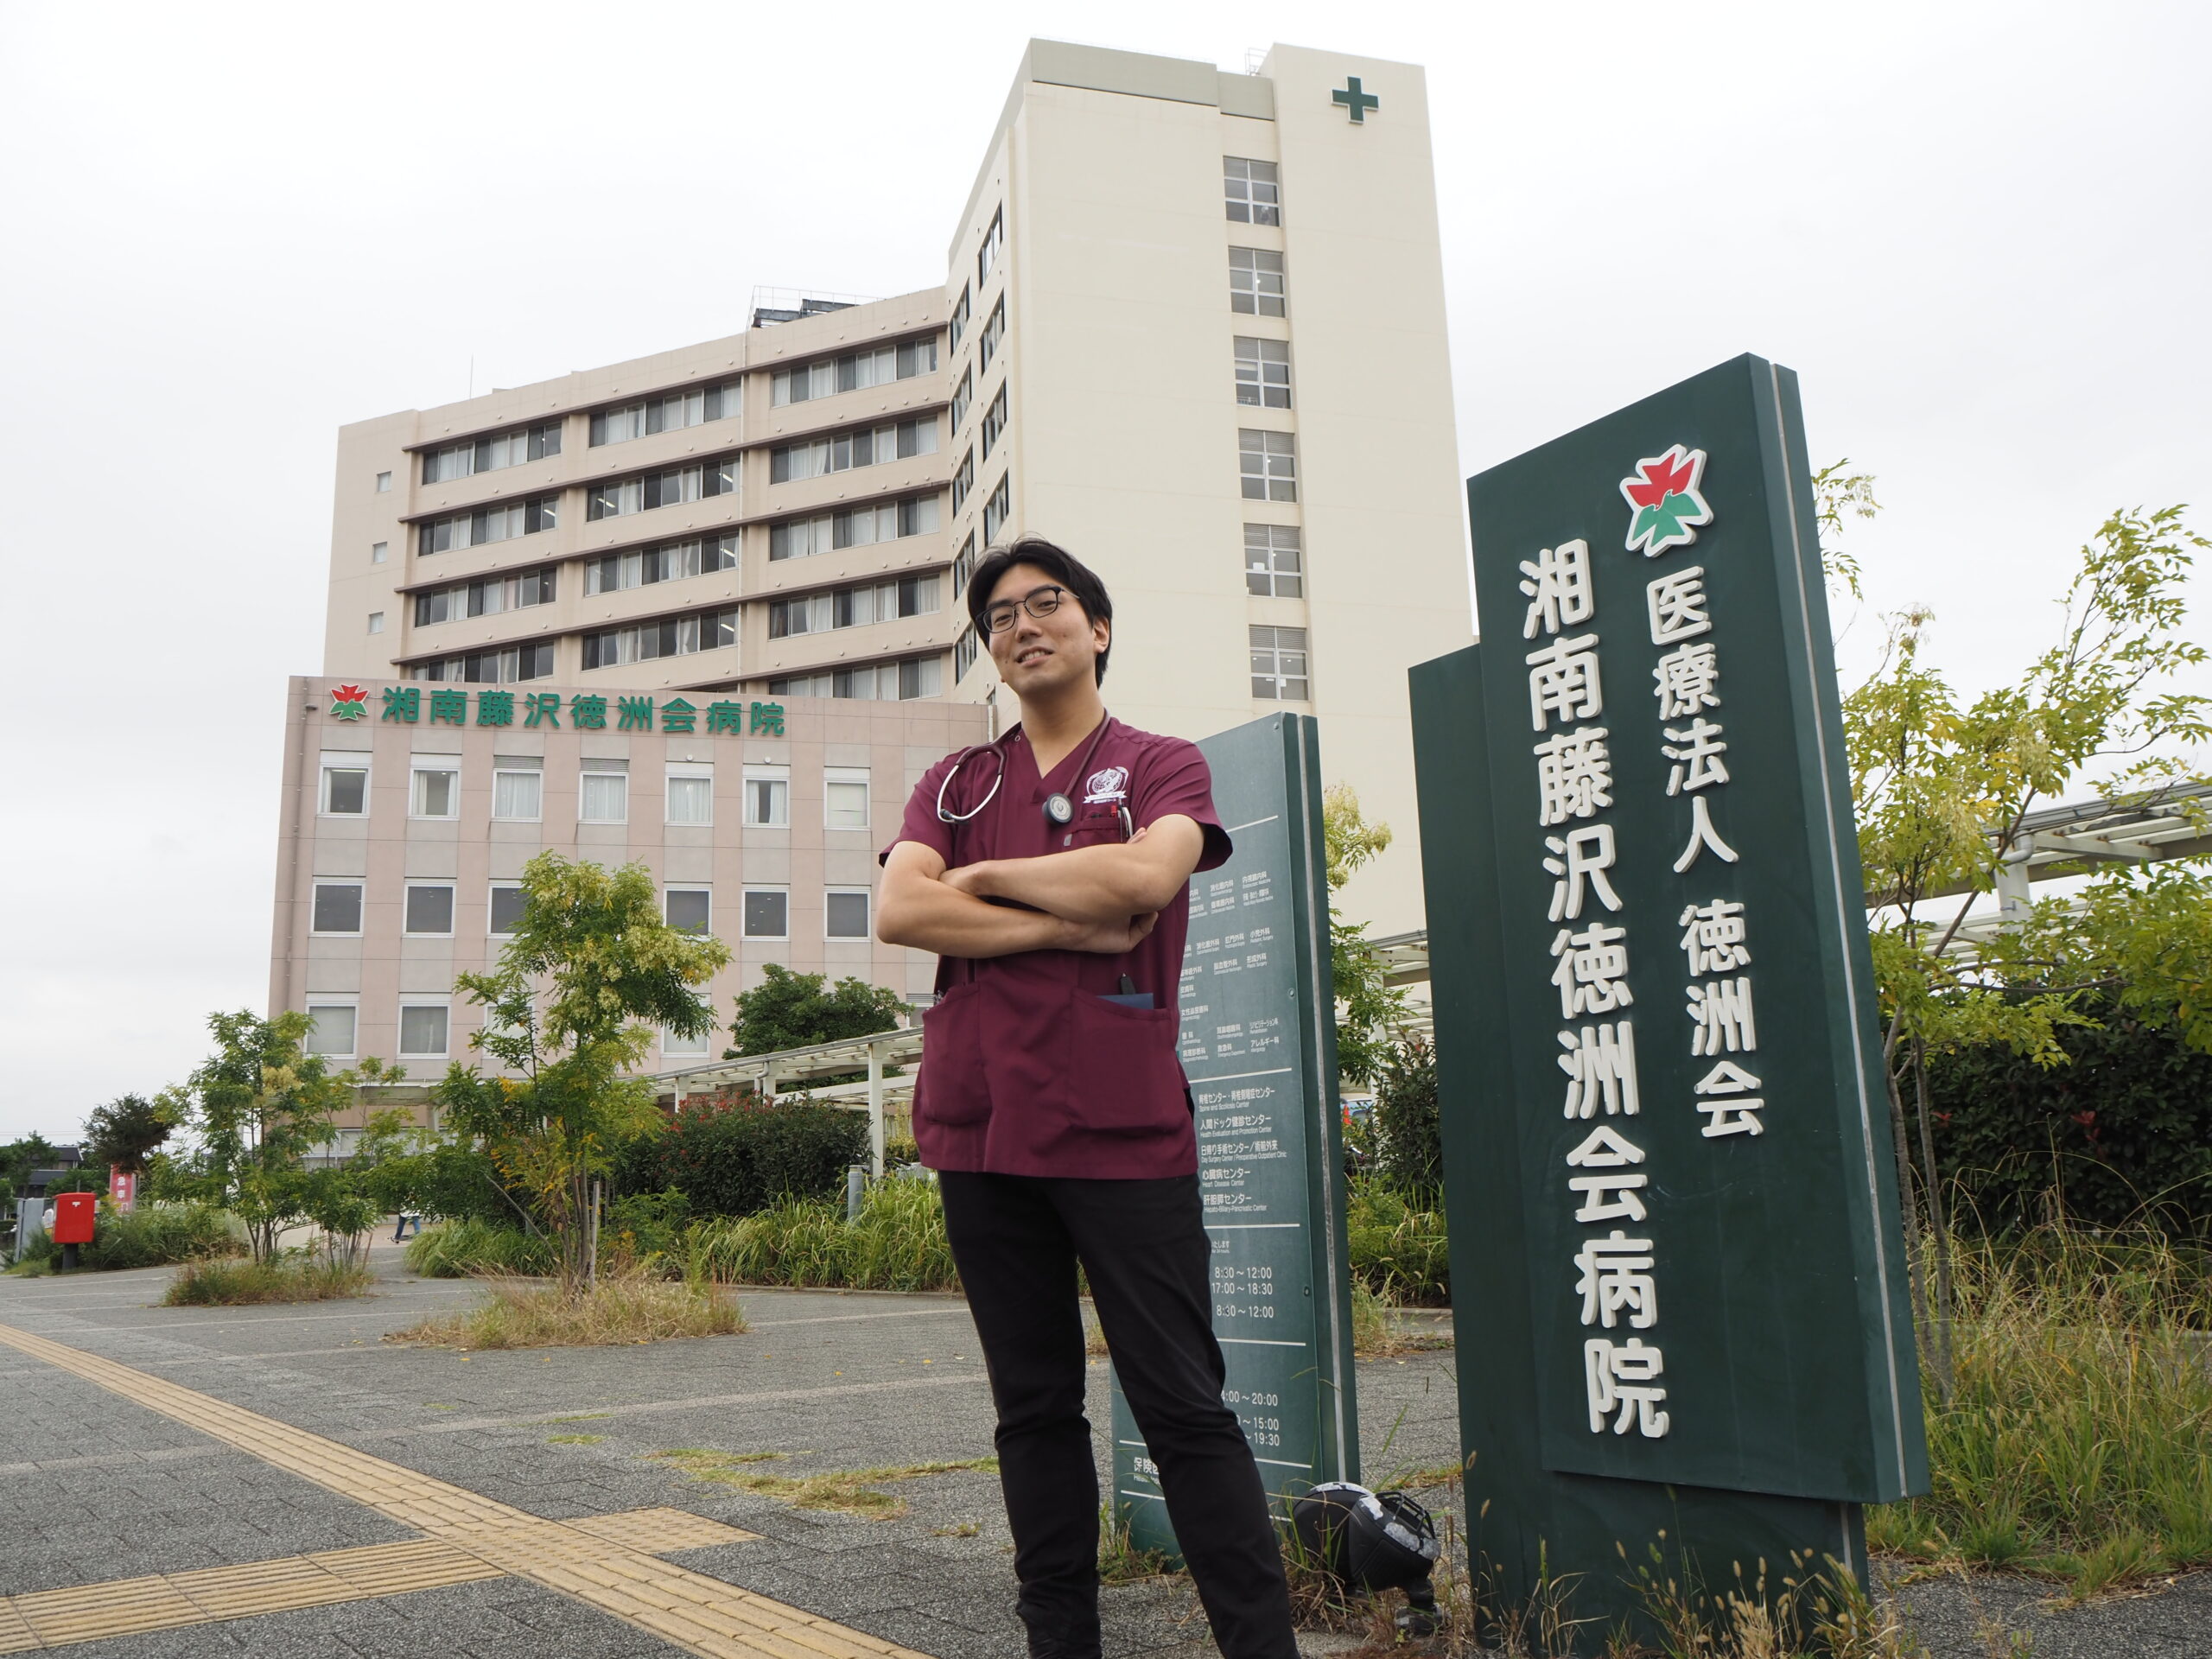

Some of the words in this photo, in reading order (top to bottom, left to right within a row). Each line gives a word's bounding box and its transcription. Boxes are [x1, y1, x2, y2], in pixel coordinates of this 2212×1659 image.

[382, 685, 785, 736] 湘南藤沢徳洲会病院
[1646, 565, 1739, 874] 医療法人
[1518, 537, 1670, 1439] 湘南藤沢徳洲会病院
[1679, 899, 1765, 1138] 徳洲会
